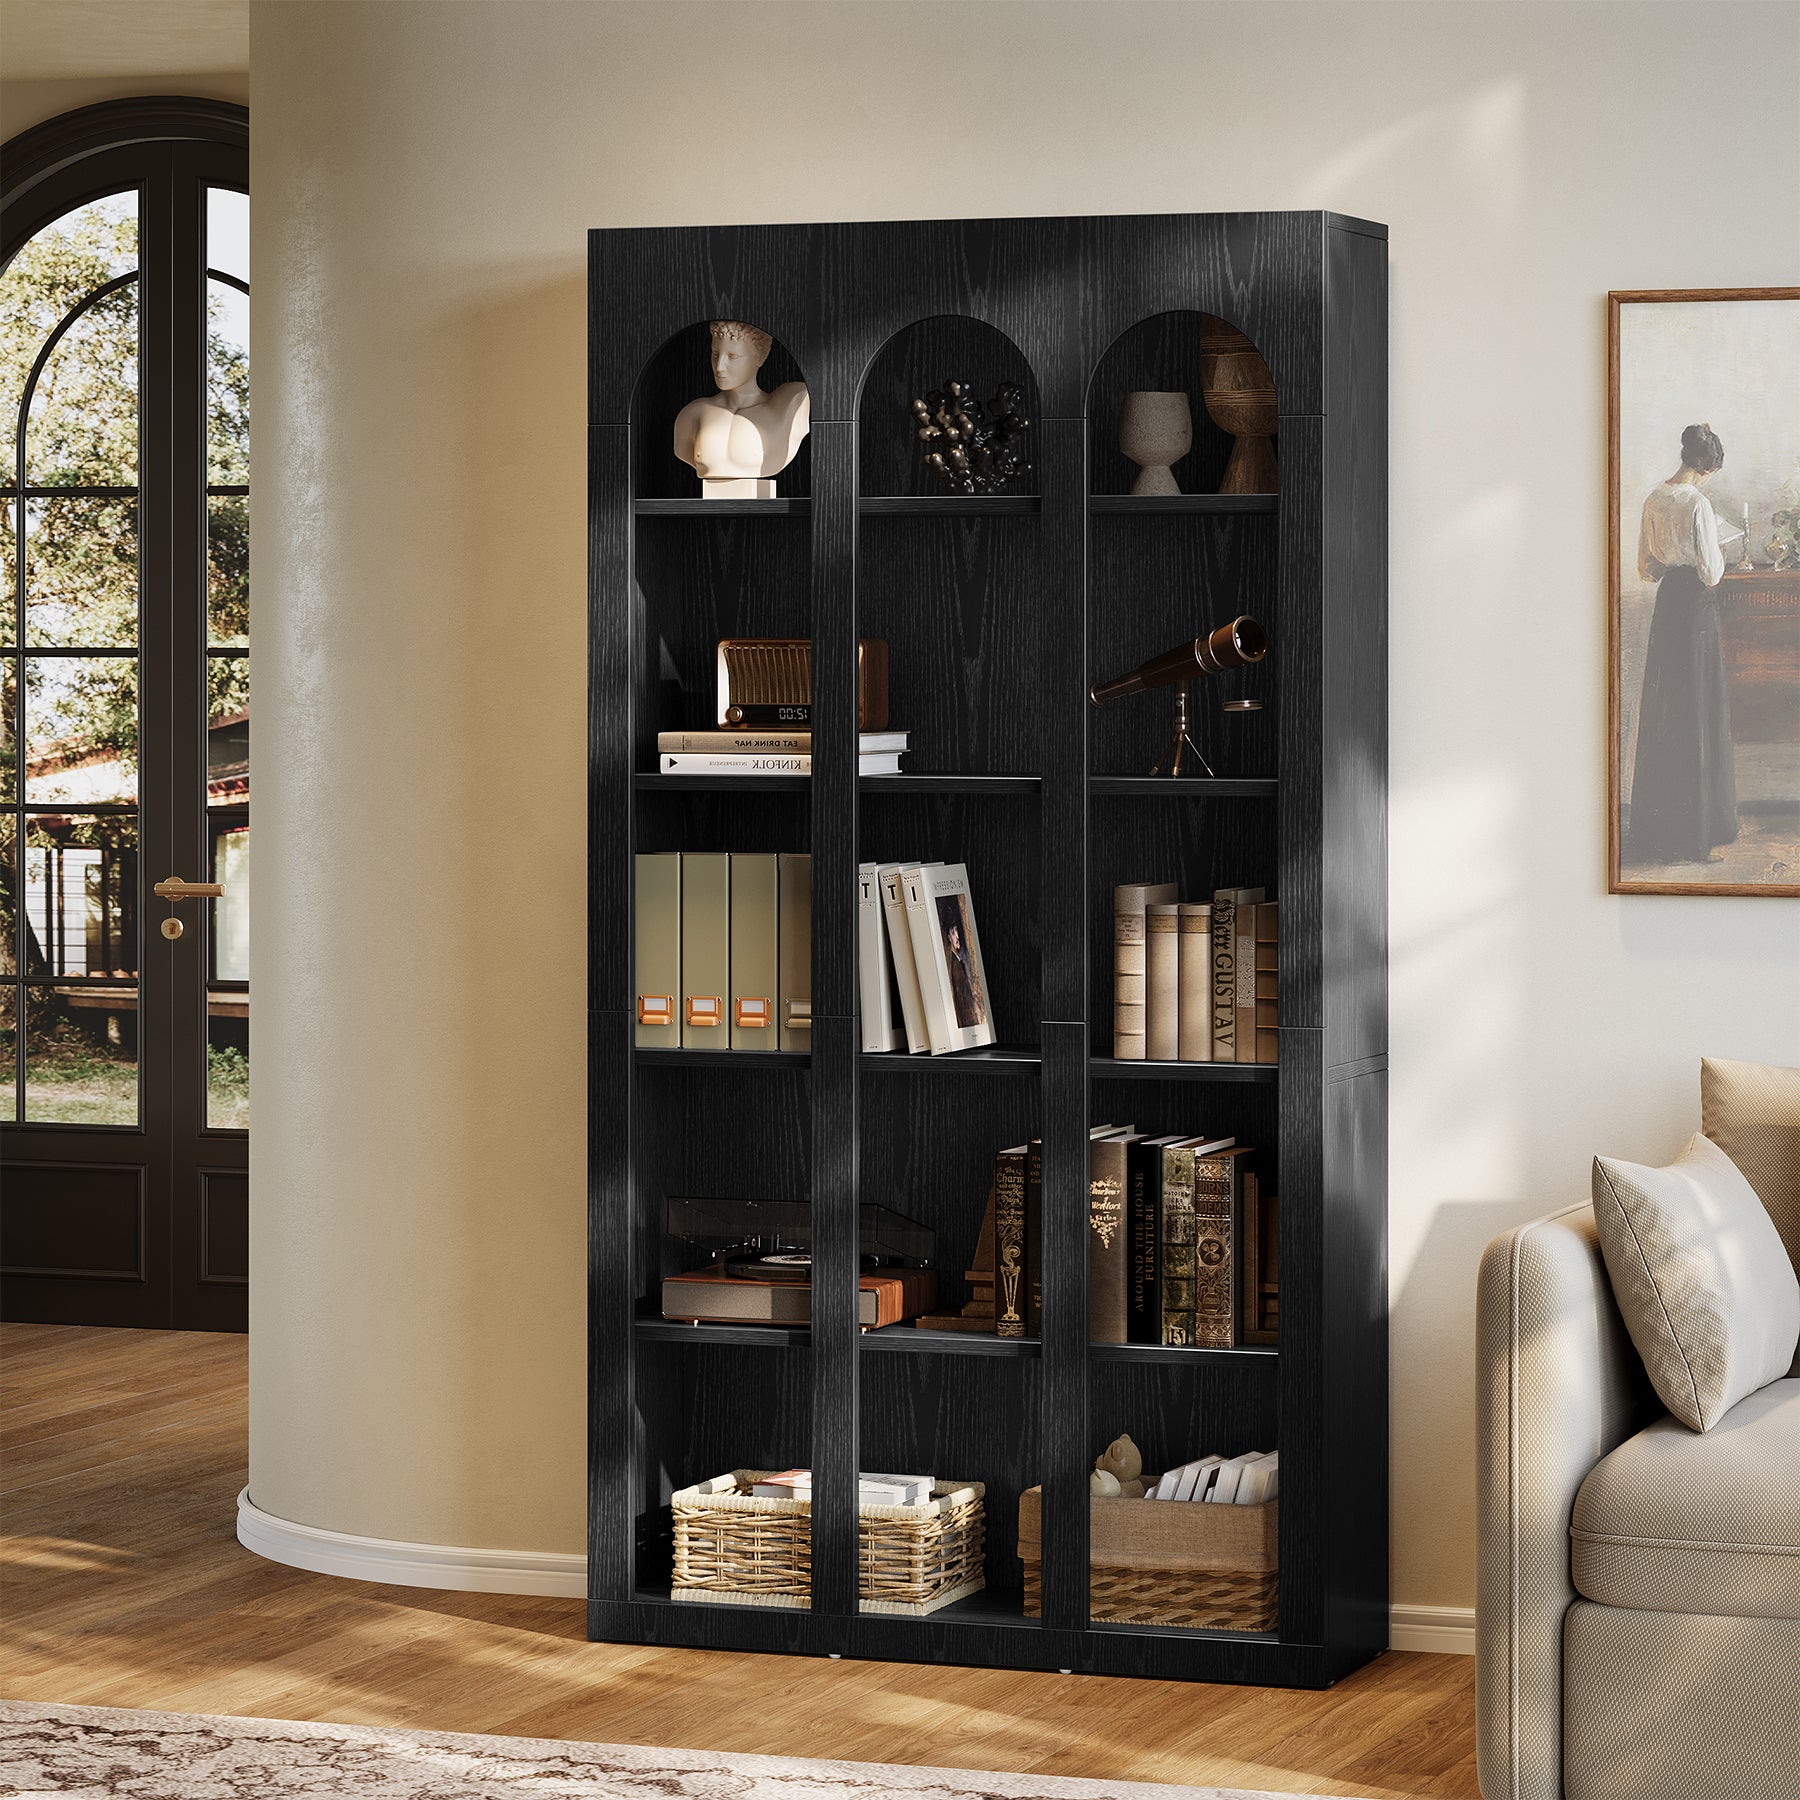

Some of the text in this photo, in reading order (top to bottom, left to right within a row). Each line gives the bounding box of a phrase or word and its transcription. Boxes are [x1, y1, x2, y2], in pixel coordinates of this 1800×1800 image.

[861, 882, 870, 899] T
[887, 884, 896, 900] T
[1215, 952, 1234, 1049] GUSTAV
[996, 1172, 1025, 1184] Charm
[1135, 1172, 1144, 1312] AROUND THE HOUSE
[1144, 1203, 1154, 1281] FURNITURE
